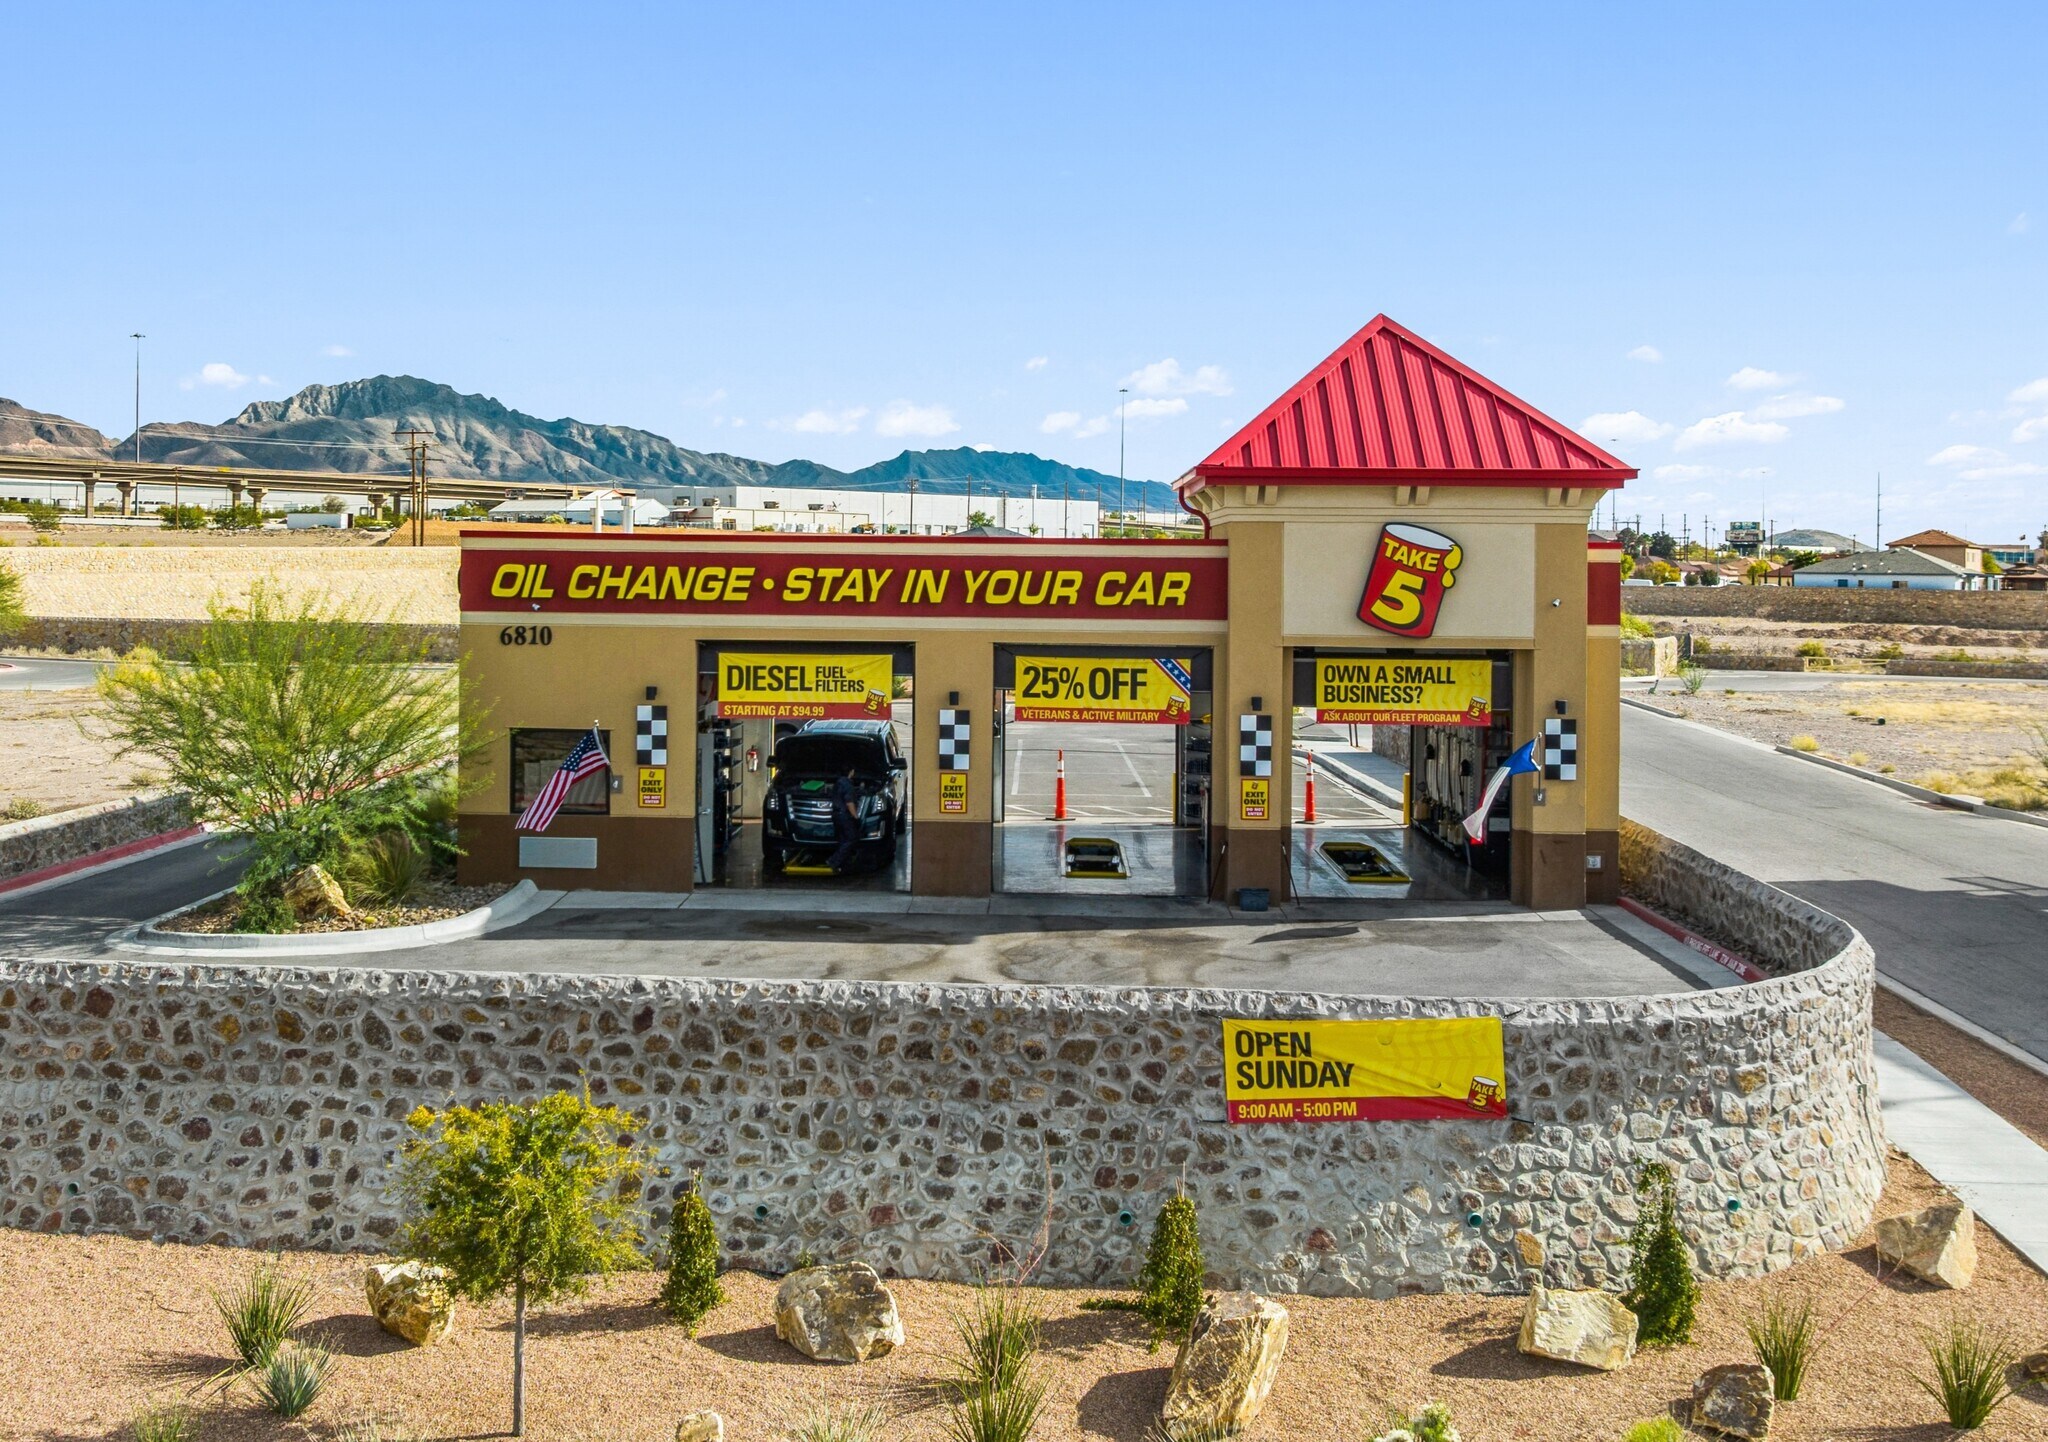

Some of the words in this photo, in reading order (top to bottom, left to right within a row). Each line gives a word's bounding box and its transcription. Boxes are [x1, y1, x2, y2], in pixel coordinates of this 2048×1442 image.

[1384, 537, 1441, 572] TAKE
[491, 564, 554, 599] OIL
[568, 565, 755, 602] CHANGE
[782, 568, 893, 603] STAY
[900, 569, 951, 604] IN
[964, 570, 1083, 605] YOUR
[1095, 571, 1191, 607] CAR
[1371, 569, 1425, 627] 5
[500, 625, 553, 646] 6810
[727, 665, 813, 692] DIESEL
[815, 666, 846, 679] FUEL
[1022, 665, 1085, 700] 25%
[1089, 667, 1148, 701] OFF
[1324, 665, 1370, 684] OWN
[1375, 666, 1390, 684] A
[1393, 665, 1456, 685] SMALL
[815, 679, 864, 693] FILTERS
[1324, 685, 1424, 704] BUSINESS?
[724, 705, 775, 716] STARTING
[778, 706, 791, 716] AT
[792, 706, 825, 717] $94.99
[868, 700, 878, 711] 5
[1168, 706, 1178, 715] 5
[1470, 707, 1480, 717] 5
[1022, 709, 1071, 720] VETERANS
[1073, 710, 1080, 720] &
[1082, 711, 1115, 721] ACTIVE
[1116, 711, 1160, 722] MILITARY
[1323, 712, 1341, 721] ASK
[1342, 712, 1372, 722] ABOUT
[1373, 712, 1391, 722] OUR
[1392, 713, 1416, 722] FLEET
[1418, 713, 1461, 723] PROGRAM
[1235, 1030, 1312, 1058] OPEN
[1236, 1060, 1354, 1090] SUNDAY
[1472, 1081, 1495, 1096] TAKE
[1473, 1093, 1487, 1107] 5
[1238, 1104, 1266, 1119] 9:00
[1269, 1103, 1293, 1118] AM
[1303, 1103, 1331, 1118] 5:00
[1333, 1102, 1357, 1117] PM
